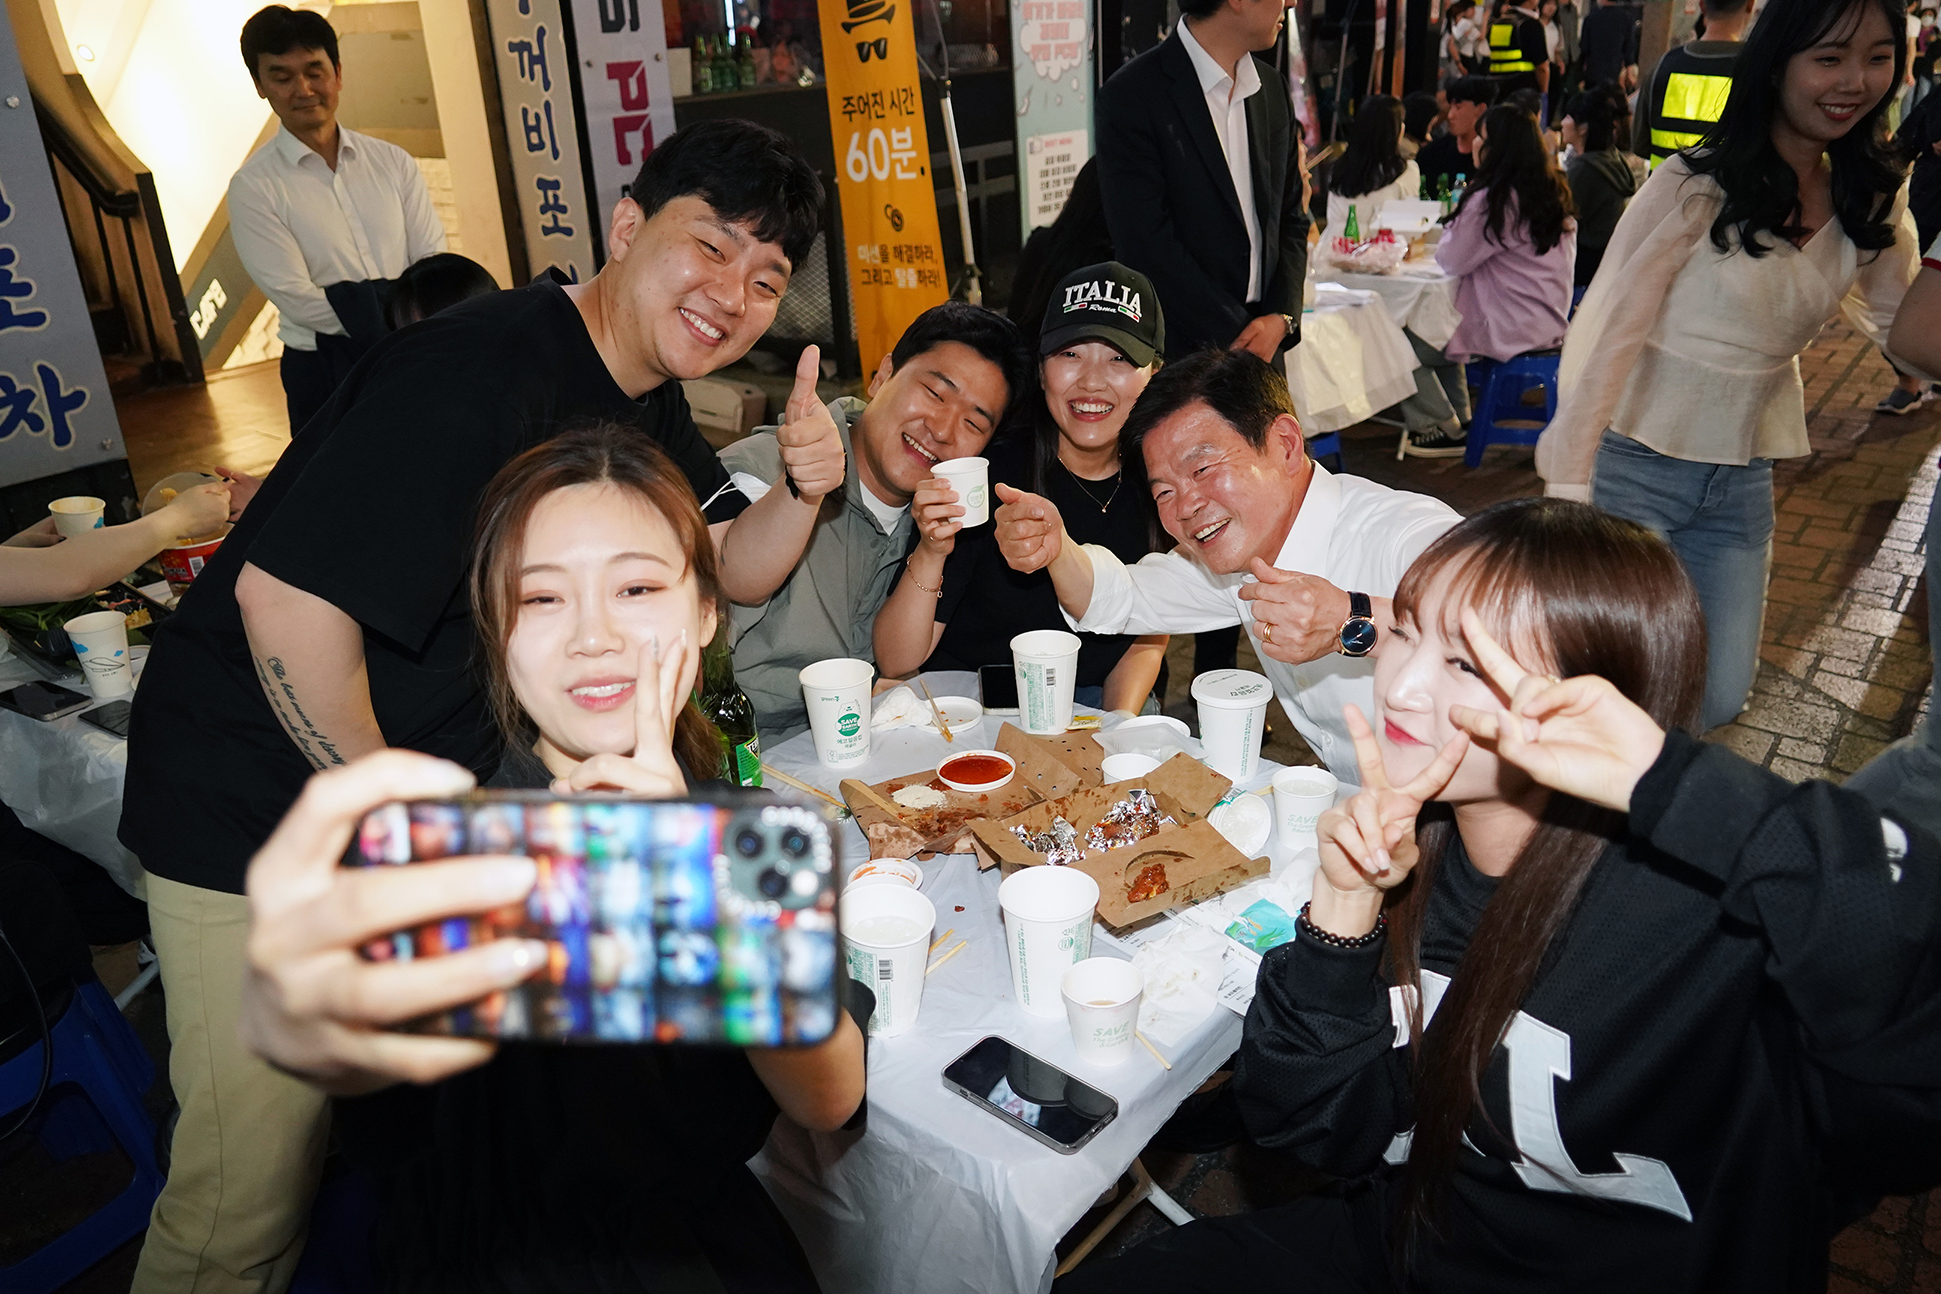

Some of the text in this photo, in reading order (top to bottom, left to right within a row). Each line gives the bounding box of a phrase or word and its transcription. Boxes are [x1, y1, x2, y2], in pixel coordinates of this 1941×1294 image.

[606, 60, 656, 166] PC
[842, 86, 915, 122] 주어진 시간
[861, 268, 893, 287] 그리고
[1062, 280, 1142, 318] ITALIA
[1088, 303, 1117, 319] Roma
[840, 716, 859, 726] SAVE
[1287, 813, 1320, 824] SAVE
[1093, 1020, 1130, 1037] SAVE
